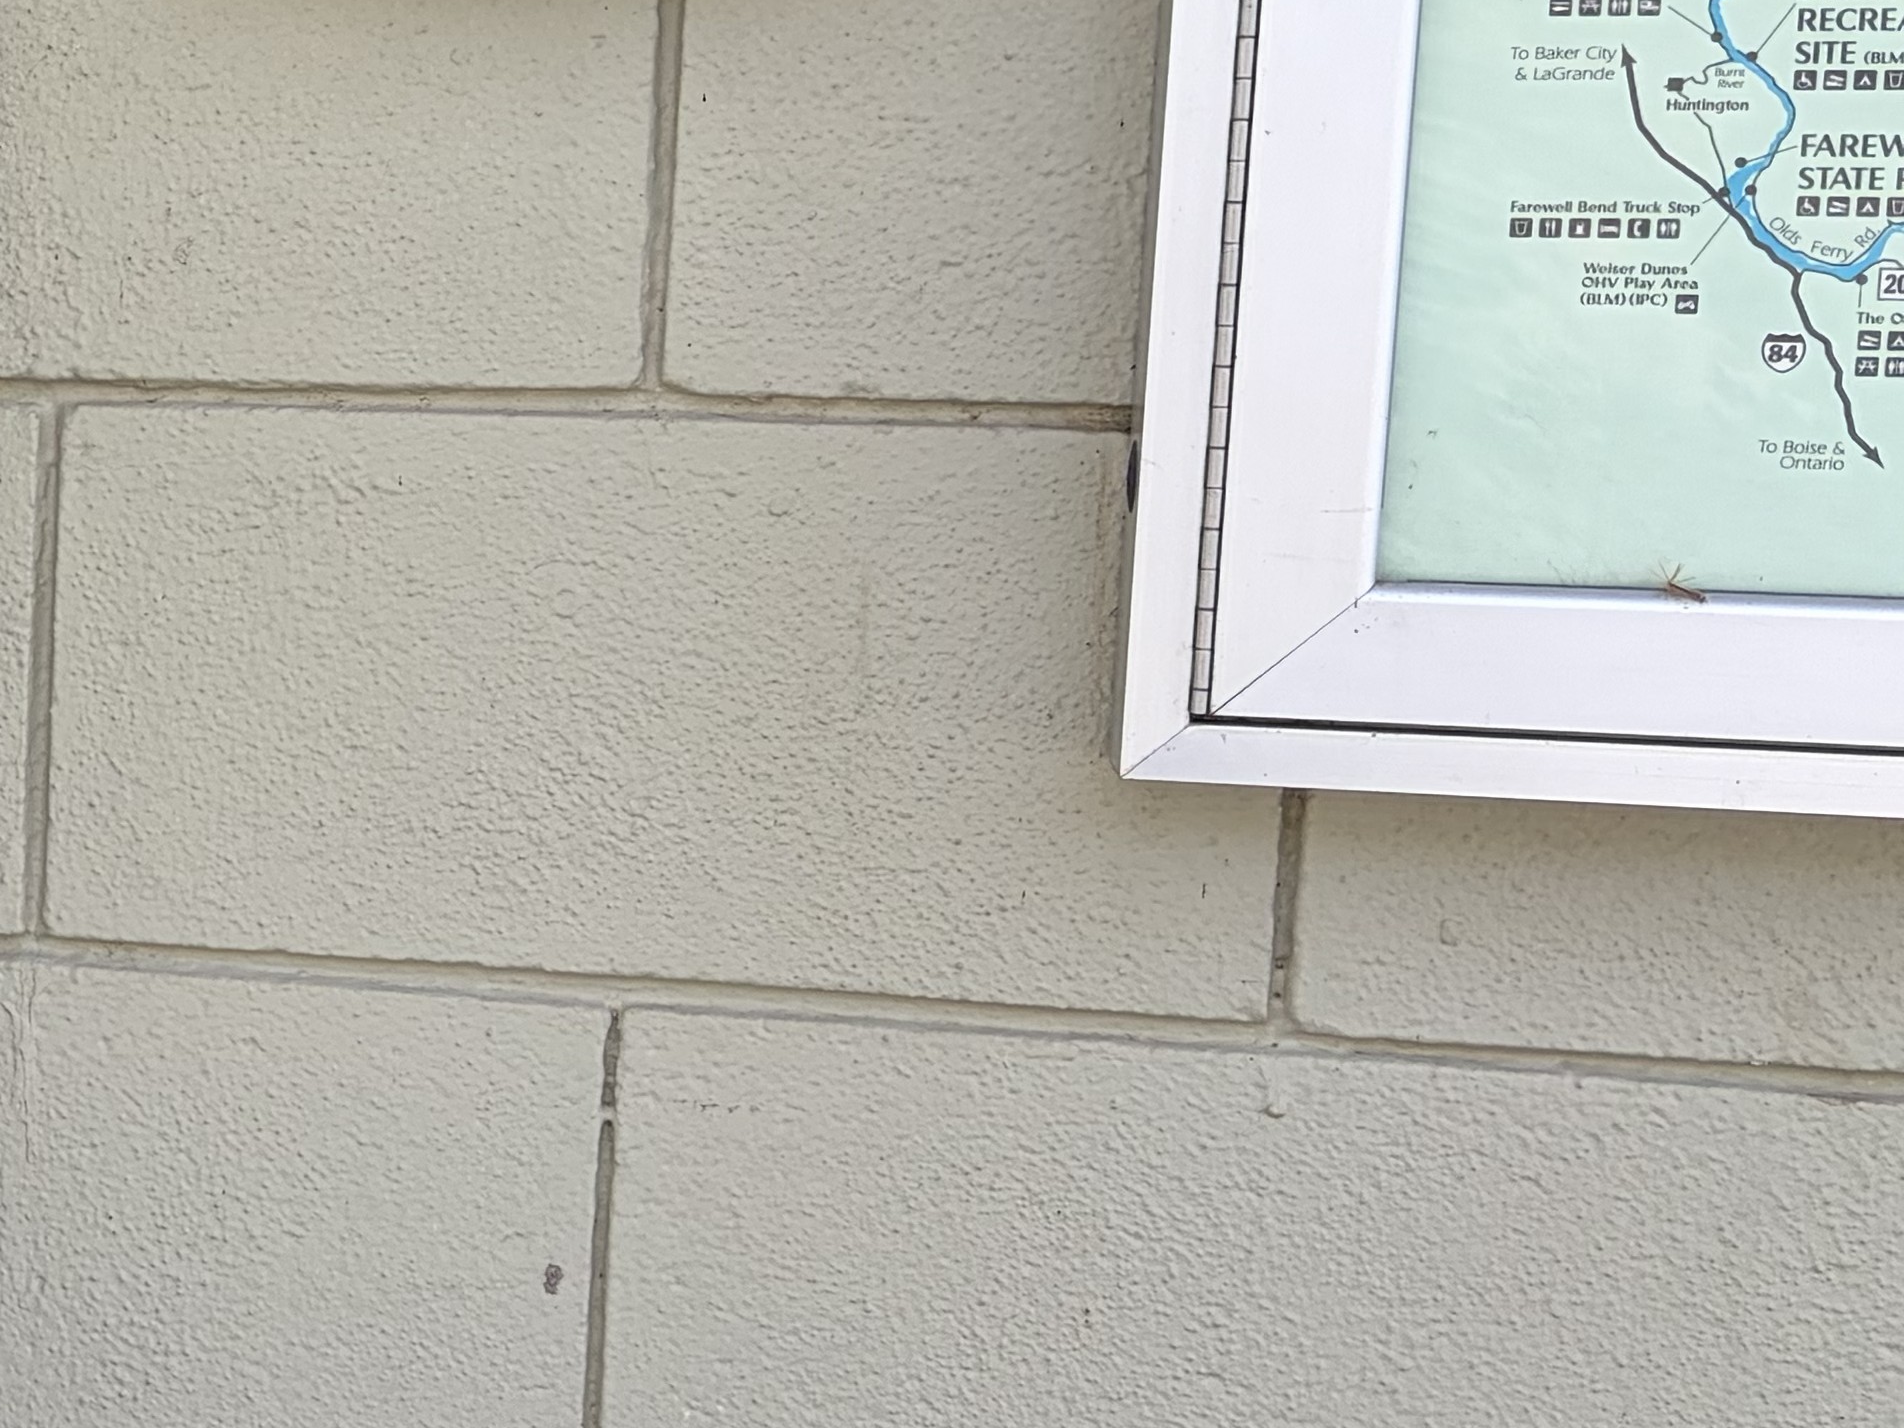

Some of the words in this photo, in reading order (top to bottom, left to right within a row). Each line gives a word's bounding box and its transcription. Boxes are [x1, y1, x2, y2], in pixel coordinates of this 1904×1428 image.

[1511, 47, 1529, 60] To
[1535, 47, 1581, 60] Baker
[1586, 46, 1617, 62] City
[1794, 41, 1857, 64] SITE
[1515, 68, 1527, 81] &
[1534, 67, 1615, 81] LaGrande
[1666, 99, 1749, 112] Huntington
[1797, 167, 1889, 190] STATE
[1510, 200, 1572, 214] Farewell
[1578, 200, 1617, 214] Bend
[1623, 200, 1662, 214] Truck
[1668, 201, 1700, 217] Stop
[1768, 344, 1798, 363] 84
[1758, 440, 1777, 454] To
[1783, 440, 1827, 454] Boise
[1832, 441, 1845, 455] &
[1780, 456, 1844, 470] Ontario
